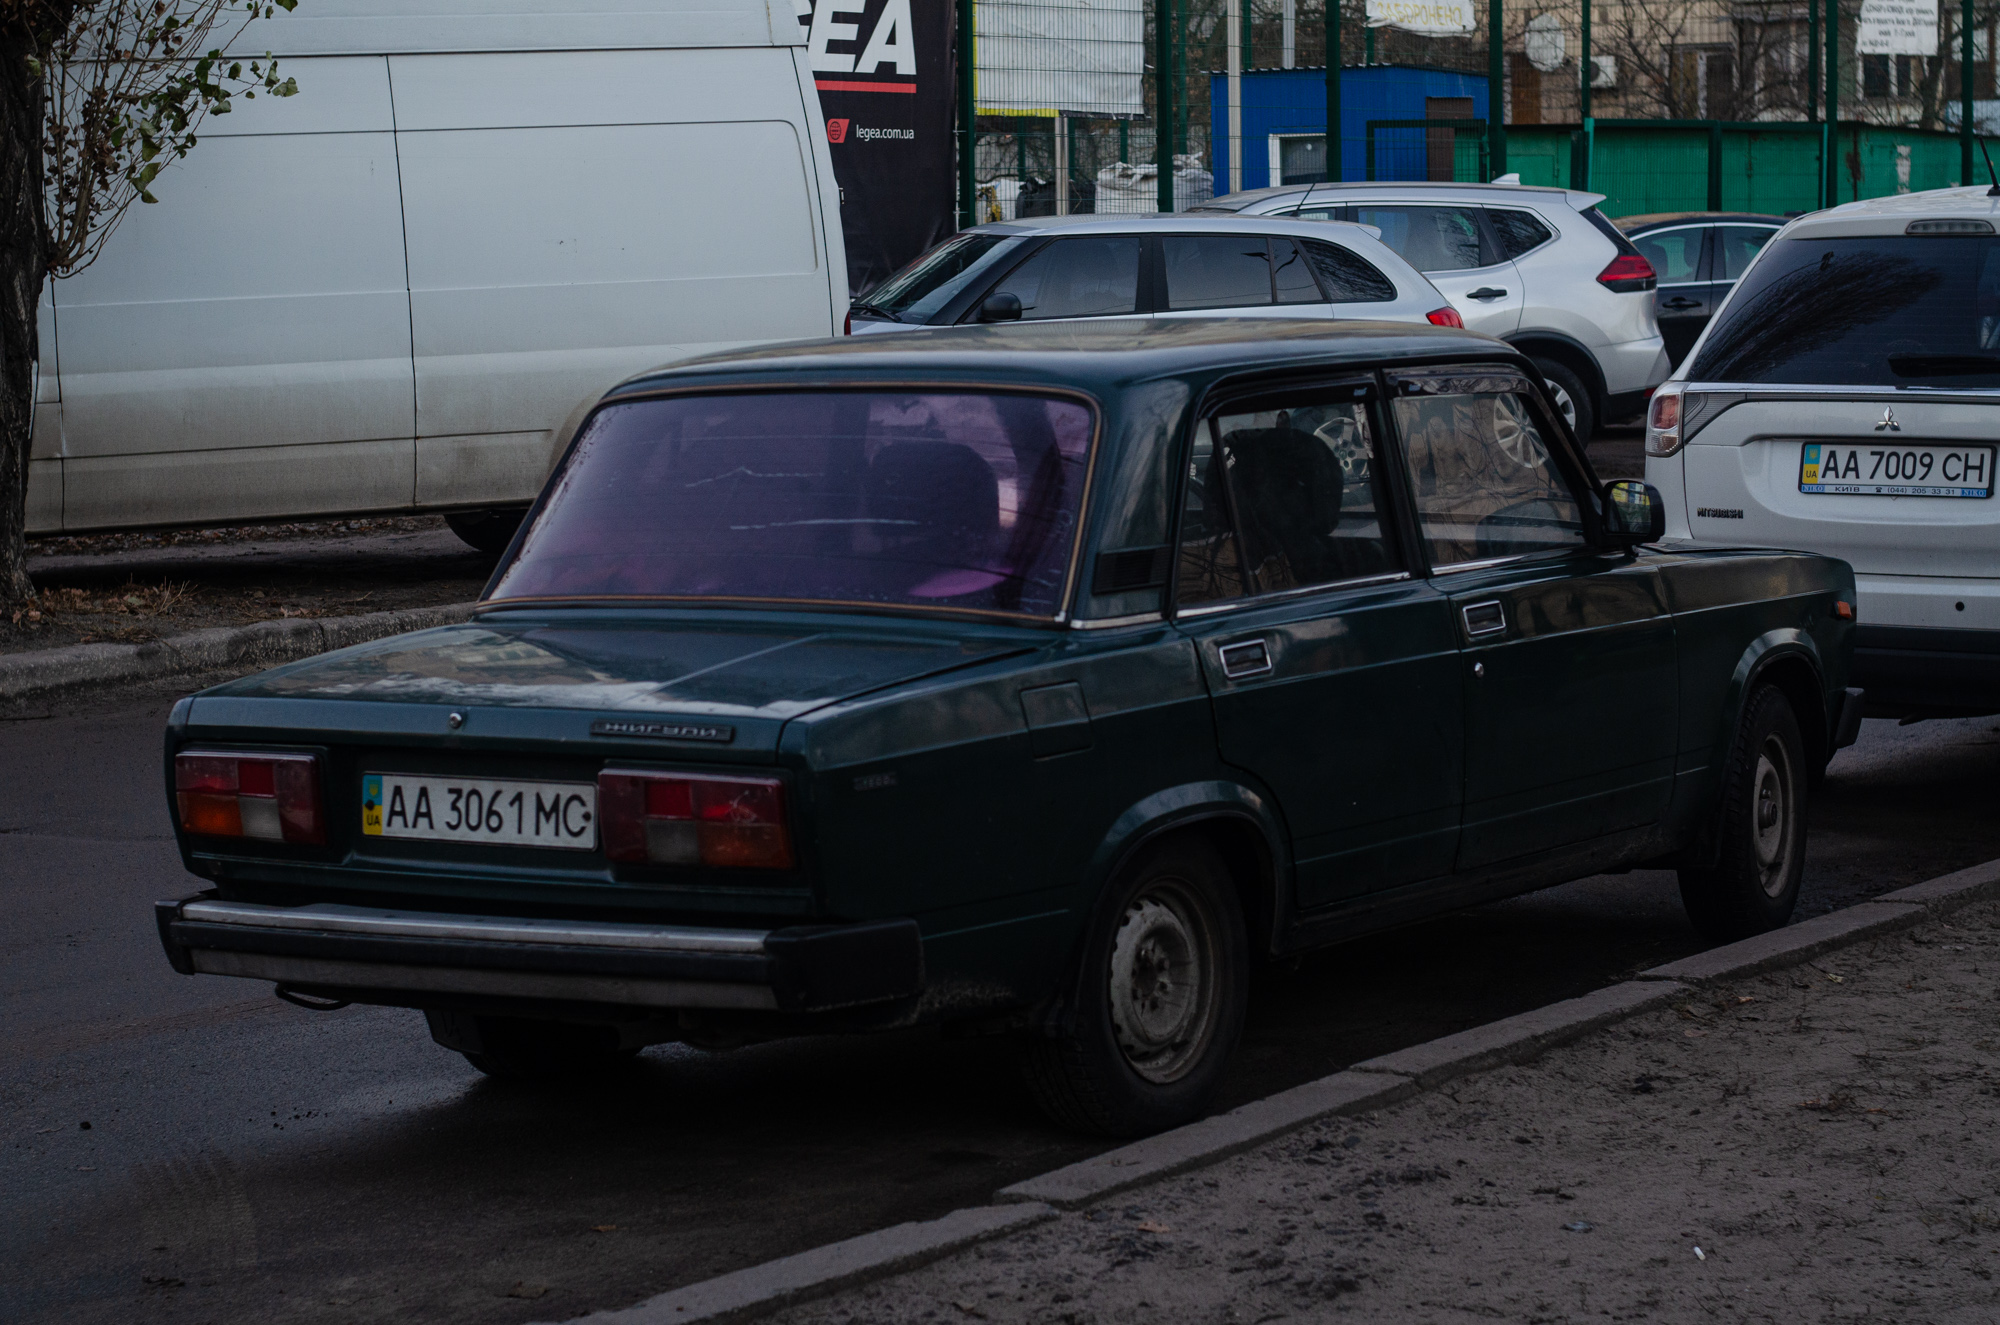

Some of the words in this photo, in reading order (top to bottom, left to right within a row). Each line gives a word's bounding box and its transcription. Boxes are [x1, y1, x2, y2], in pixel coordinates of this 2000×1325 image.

[1377, 2, 1462, 25] ЗАБОРОНЕНО
[795, 0, 917, 75] EA
[856, 124, 915, 141] legea.com.ua
[1805, 470, 1817, 479] UA
[1821, 450, 1860, 479] AA
[1869, 451, 1934, 481] 7009
[1942, 453, 1985, 482] CH
[1834, 485, 1860, 493] КИЇВ
[1696, 507, 1744, 519] MITSUBISHI
[366, 814, 381, 826] UA
[386, 785, 435, 830] AA
[445, 788, 524, 834] 3061
[535, 792, 589, 838] MC
